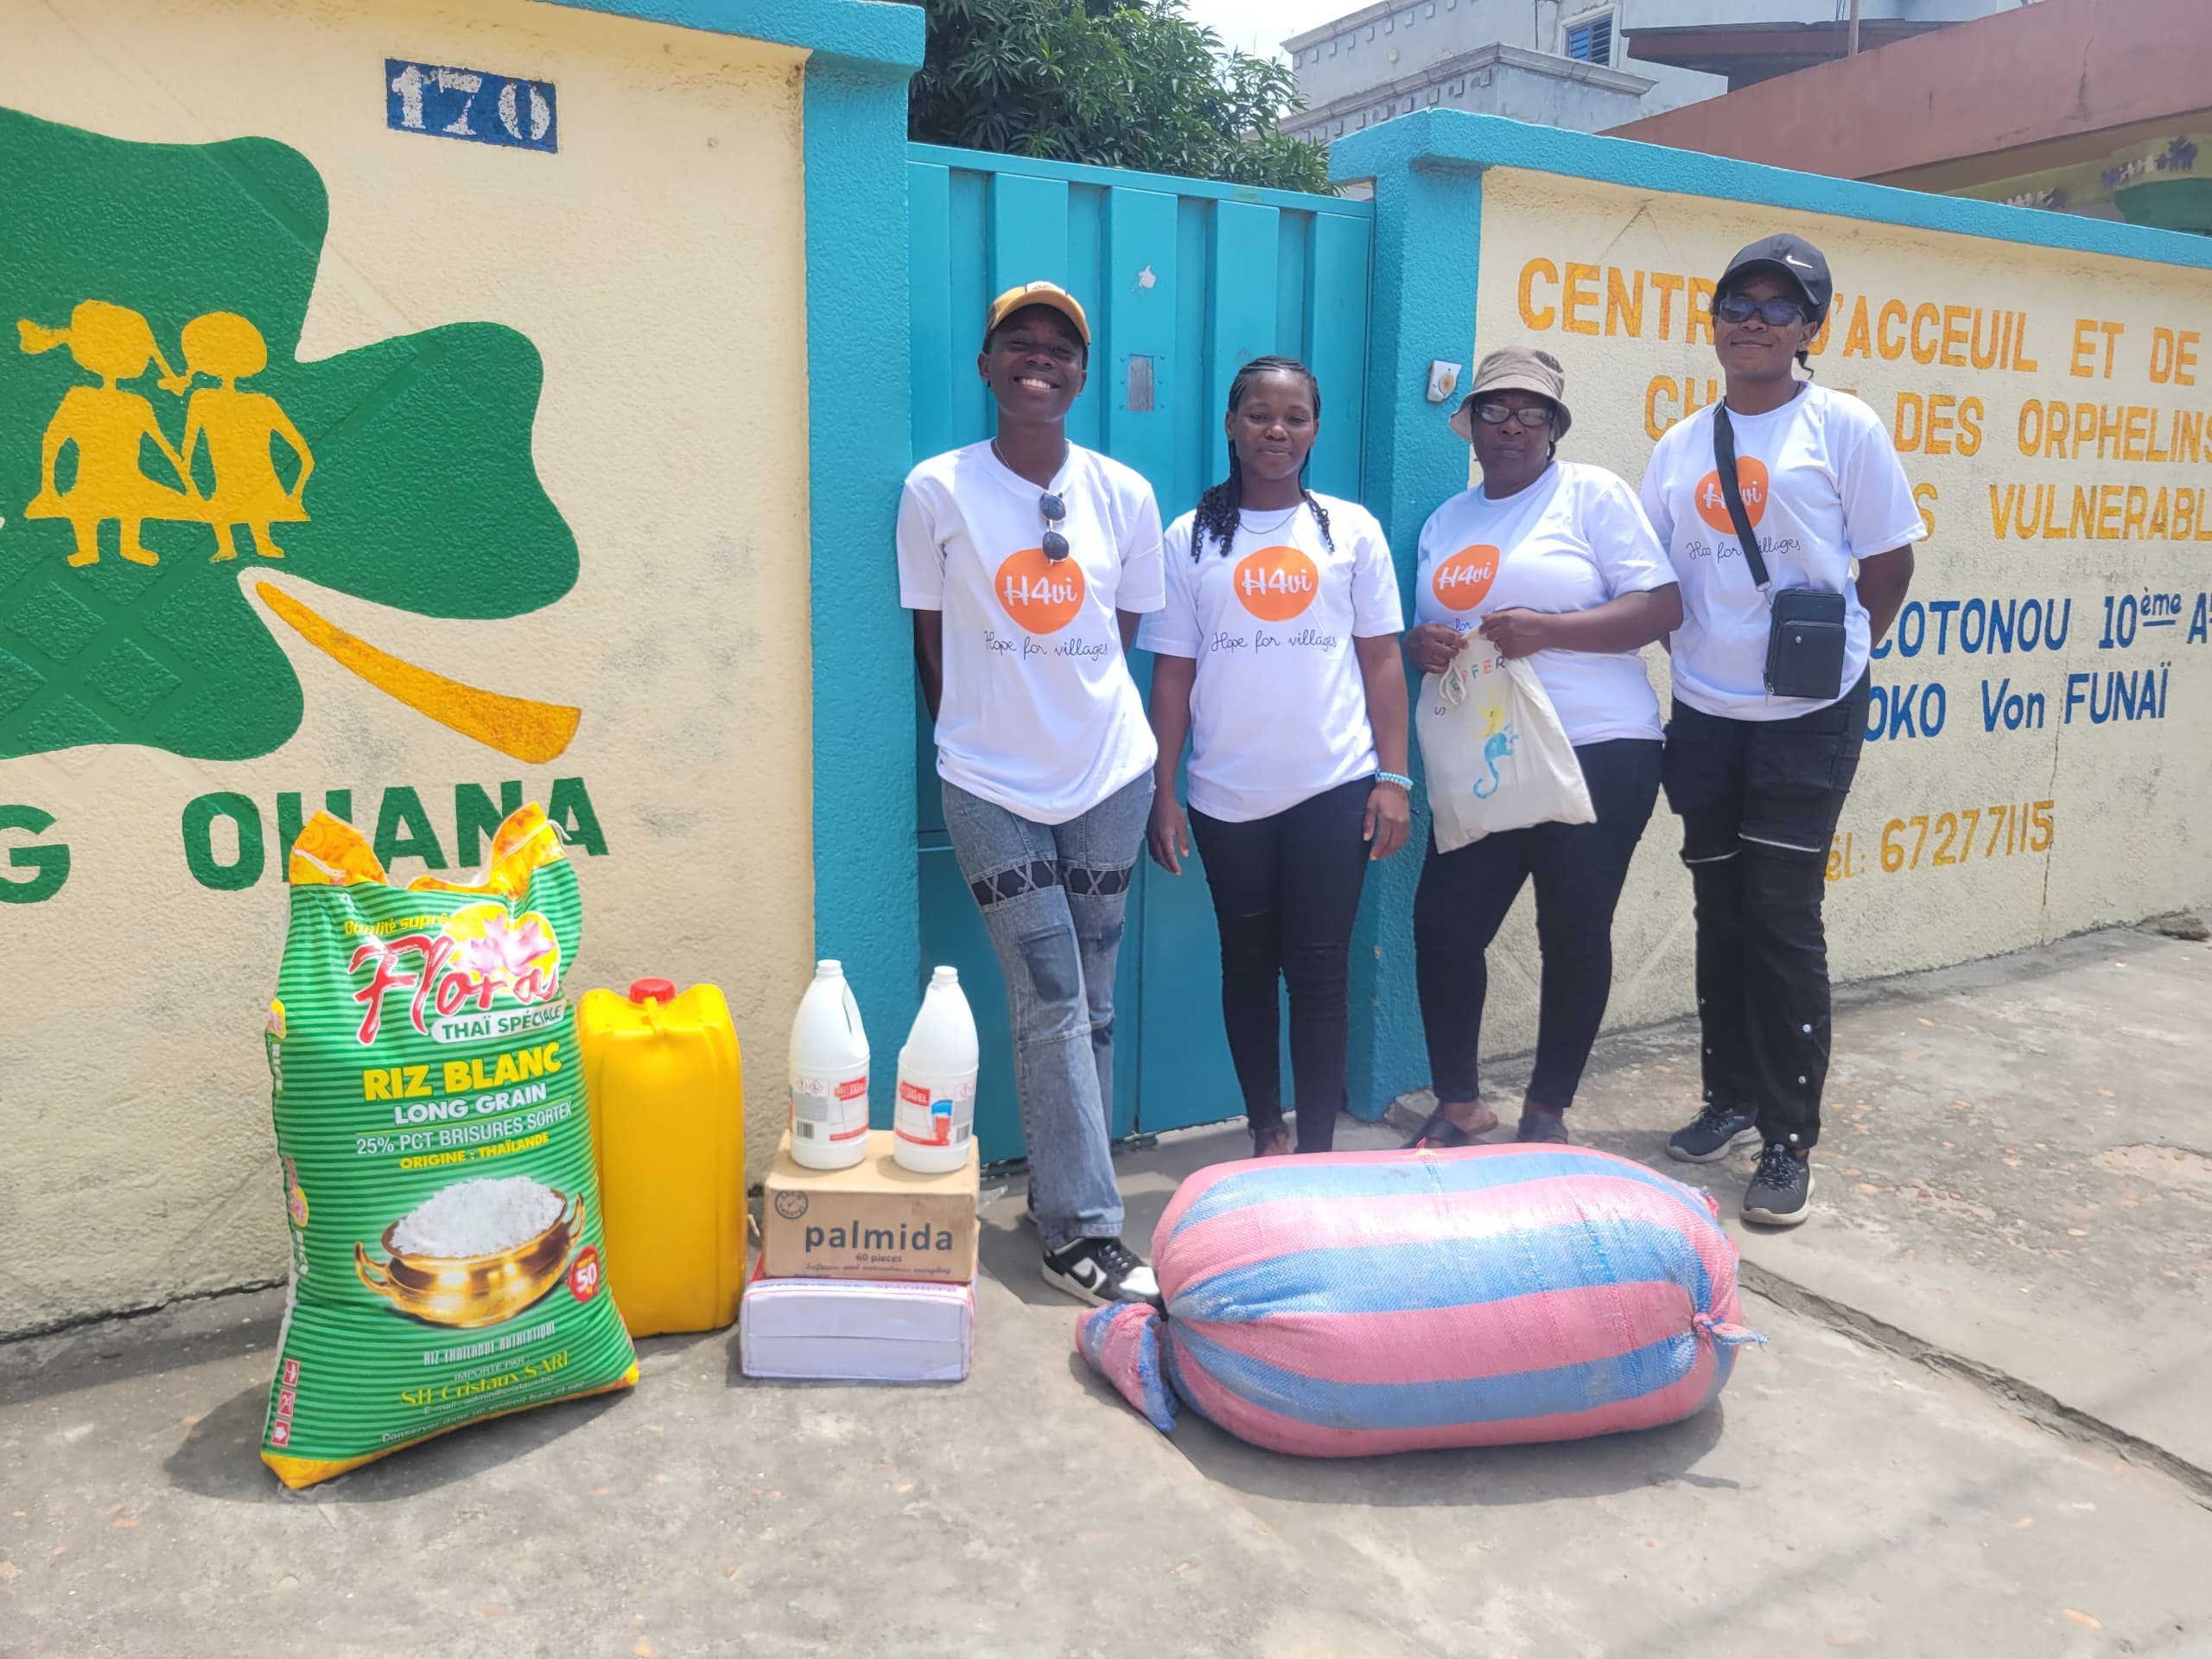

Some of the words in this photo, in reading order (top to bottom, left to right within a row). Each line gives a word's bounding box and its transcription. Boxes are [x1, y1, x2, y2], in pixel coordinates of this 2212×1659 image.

[391, 66, 550, 140] 170
[1518, 257, 1718, 346] CENTR
[2069, 318, 2124, 379] ET
[2149, 327, 2200, 386] DE
[1894, 391, 1984, 457] DES
[1703, 480, 1763, 510] Hvi
[1758, 536, 1801, 554] illages
[1003, 575, 1078, 607] H4vi
[1242, 567, 1313, 596] H4vi
[1437, 561, 1492, 591] H4vi
[2098, 586, 2183, 649] 10ème
[2186, 592, 2212, 645] A
[983, 630, 1016, 656] Hope
[1023, 636, 1047, 660] for
[1054, 638, 1108, 661] villages
[1211, 632, 1248, 652] Hope
[1255, 630, 1281, 654] for
[1865, 682, 1946, 742] OKO
[1981, 677, 2045, 733] Von
[2064, 661, 2171, 725] FUNAÏ
[1825, 832, 1866, 882] él:
[347, 935, 560, 1046] Flora
[442, 1014, 491, 1041] THAÏ
[362, 1065, 433, 1102] RIZ
[442, 1041, 562, 1094] BLANC
[394, 1099, 469, 1125] LONG
[475, 1082, 547, 1115] GRAIN
[356, 1136, 395, 1155] 25%
[400, 1131, 435, 1152] PCT
[439, 1116, 524, 1148] BRISURES
[527, 1099, 573, 1130] SORTEX
[399, 1150, 467, 1170] ORIGINE
[478, 1130, 550, 1160] THAÏLANDE
[804, 1219, 954, 1253] palmida
[855, 1252, 869, 1262] 60
[871, 1254, 903, 1263] pieces
[575, 1262, 598, 1294] 50
